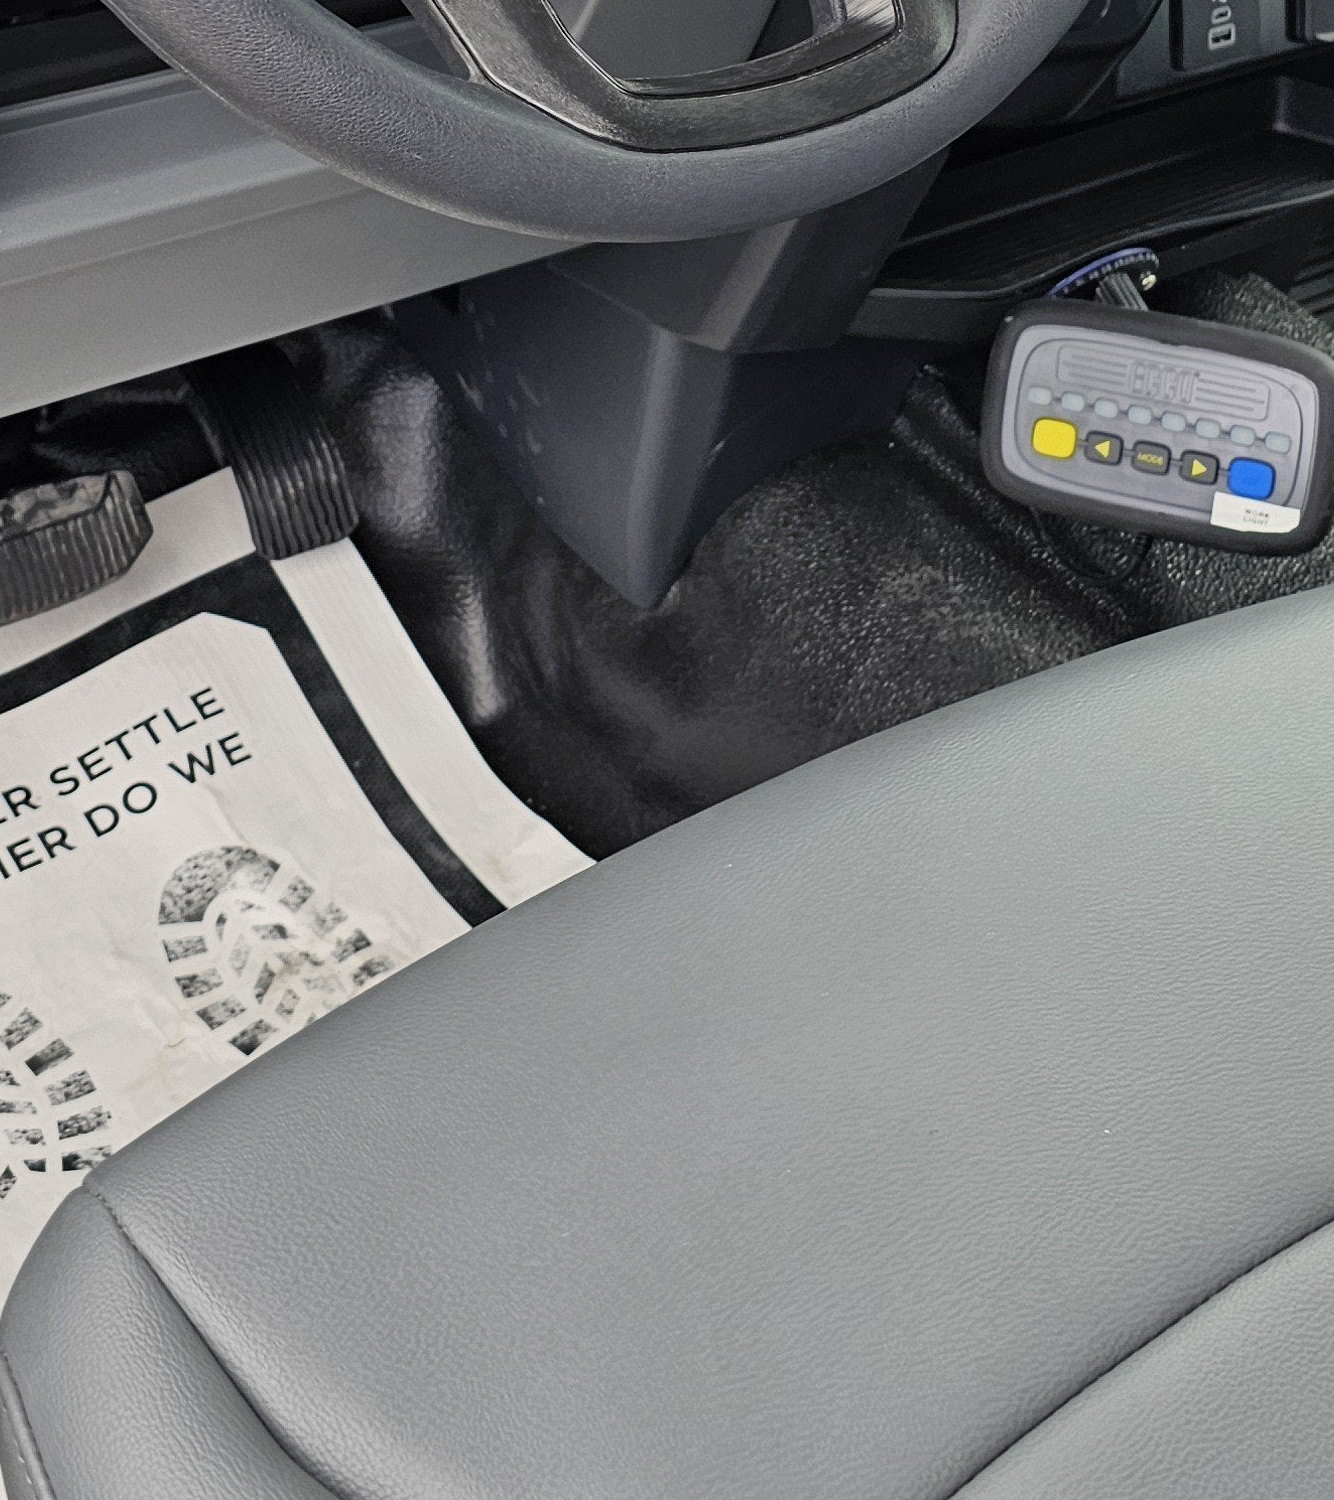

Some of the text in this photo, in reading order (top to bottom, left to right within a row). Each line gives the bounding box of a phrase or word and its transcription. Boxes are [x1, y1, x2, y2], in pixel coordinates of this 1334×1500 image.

[48, 686, 226, 797] SETTLE
[84, 781, 158, 838] DO
[168, 731, 252, 784] WE
